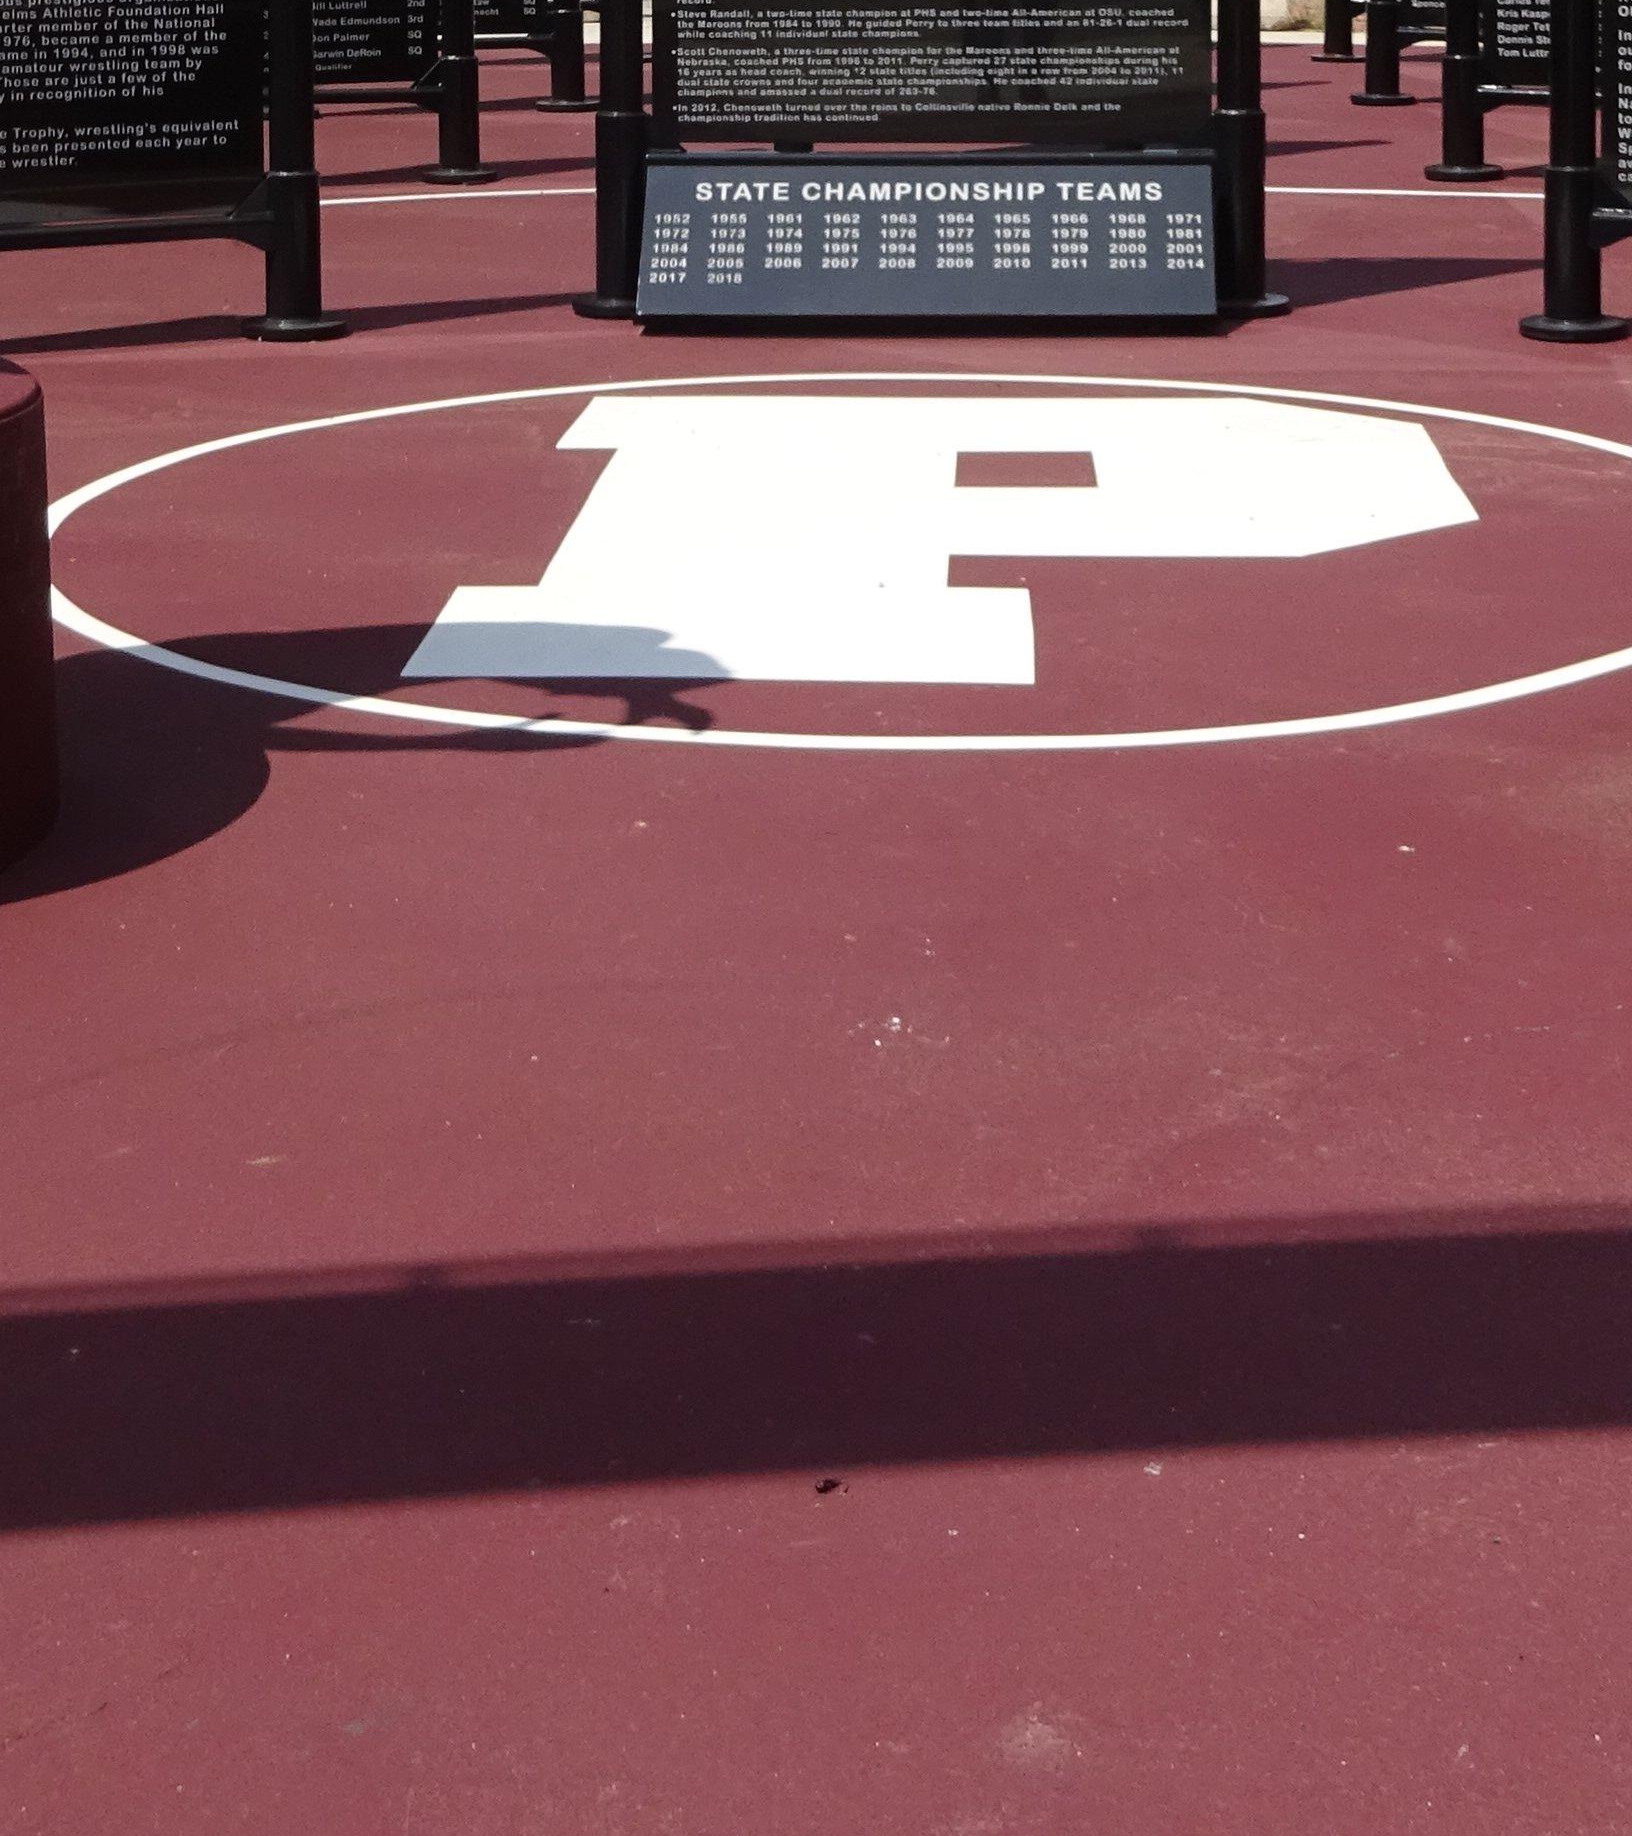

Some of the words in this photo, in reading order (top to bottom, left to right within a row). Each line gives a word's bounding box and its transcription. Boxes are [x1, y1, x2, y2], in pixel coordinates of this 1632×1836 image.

[695, 182, 790, 202] STATE
[801, 182, 1045, 202] CHAMPIONSHIP
[1056, 182, 1163, 202] TEAMS
[823, 213, 861, 225] 1962
[880, 213, 918, 225] 1963
[937, 212, 975, 224] 1964
[994, 213, 1031, 225] 1965
[1051, 213, 1089, 225] 1966
[1108, 213, 1147, 225] 1968
[1166, 213, 1202, 225] 1971
[654, 227, 690, 239] 1972
[710, 228, 746, 239] 1973
[767, 227, 803, 240] 1974
[823, 227, 860, 239] 1975
[880, 227, 918, 239] 1976
[937, 227, 975, 239] 1977
[994, 227, 1031, 239] 1978
[1051, 227, 1089, 239] 1979
[1109, 227, 1147, 240] 1980
[1166, 228, 1203, 240] 1981
[653, 242, 689, 254] 1984
[822, 242, 858, 254] 1991
[879, 242, 917, 254] 1994
[937, 242, 975, 254] 1995
[994, 242, 1031, 254] 1998
[1051, 242, 1089, 254] 1999
[1108, 242, 1147, 255] 2000
[1166, 243, 1203, 254] 2001
[650, 257, 687, 269] 2004
[764, 257, 802, 269] 2006
[821, 257, 859, 269] 2007
[878, 257, 917, 270] 2008
[936, 257, 974, 269] 2009
[993, 257, 1031, 269] 2010
[1051, 257, 1088, 269] 2011
[1109, 257, 1147, 270] 2013
[1166, 258, 1205, 270] 2014
[649, 271, 687, 284] 2017
[707, 272, 743, 284] 2018
[400, 395, 1479, 685] P
